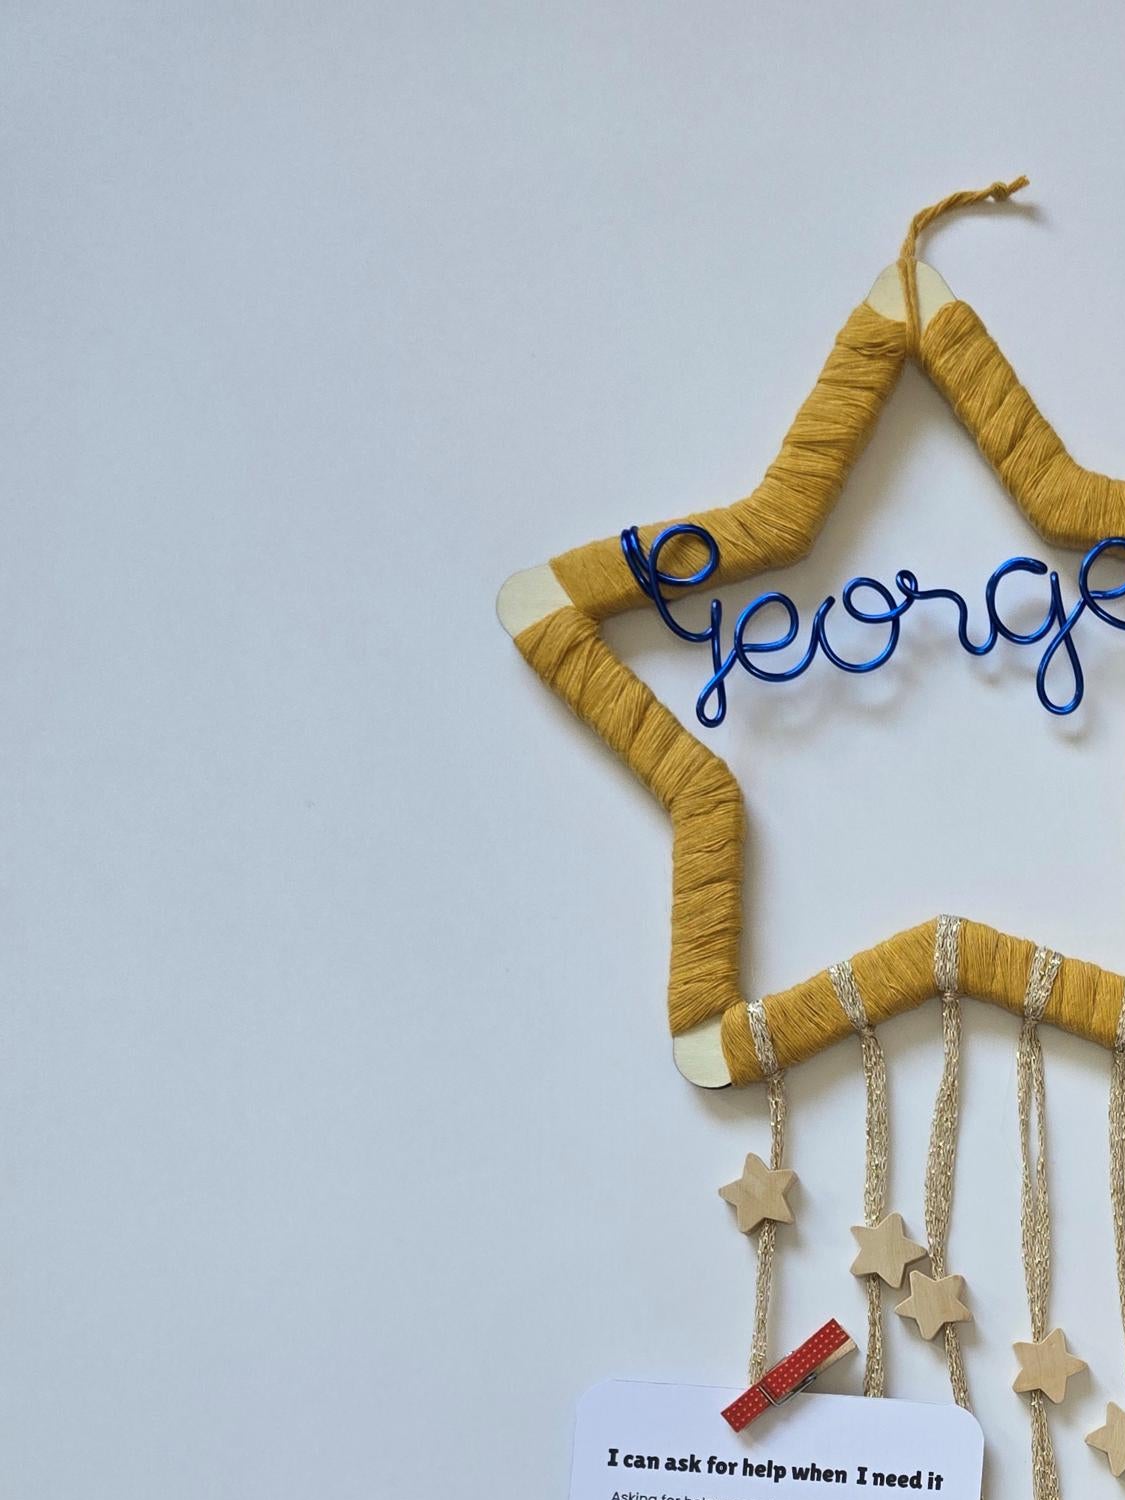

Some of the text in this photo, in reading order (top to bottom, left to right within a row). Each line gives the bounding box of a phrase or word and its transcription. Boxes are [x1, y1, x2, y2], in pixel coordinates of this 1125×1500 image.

[606, 1447, 944, 1491] I can ask for help when I need it
